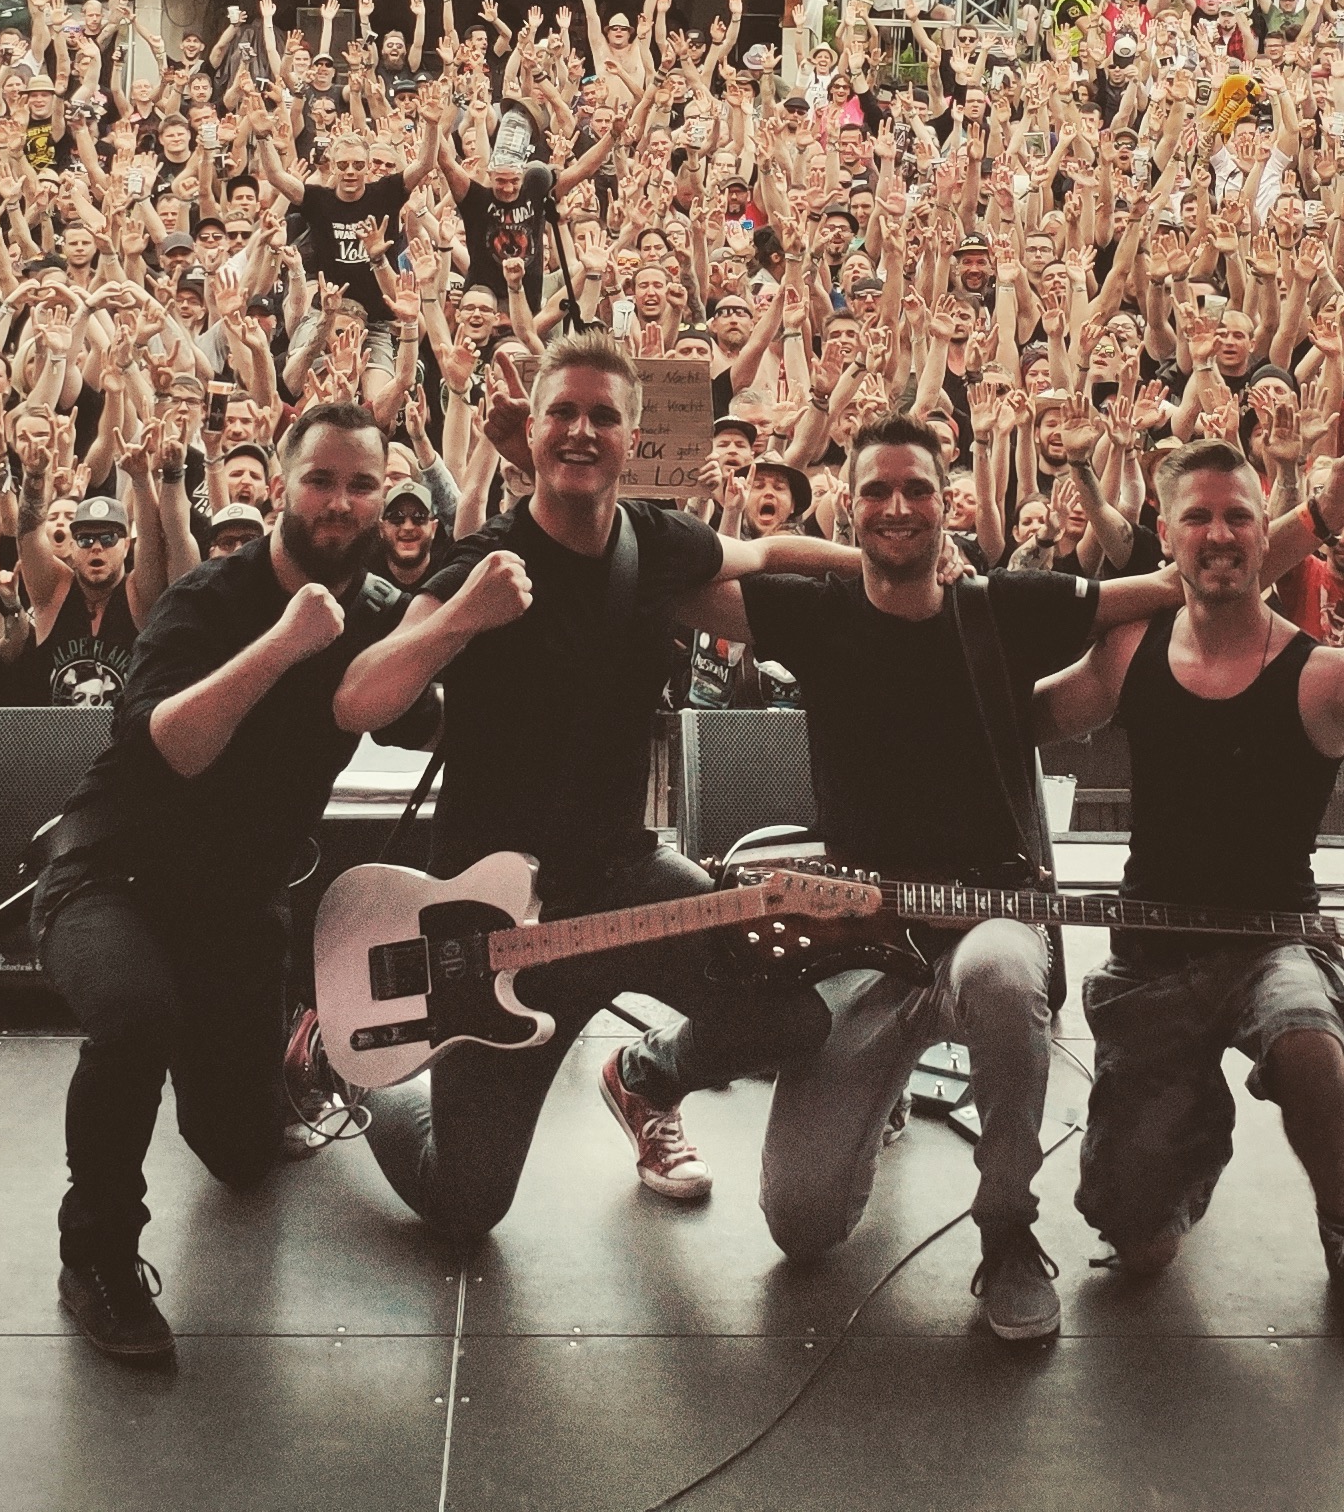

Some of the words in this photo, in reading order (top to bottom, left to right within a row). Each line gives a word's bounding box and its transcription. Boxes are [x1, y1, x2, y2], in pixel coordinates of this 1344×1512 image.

[636, 441, 666, 459] ICK
[655, 466, 699, 487] LOS
[53, 638, 88, 667] ALPE
